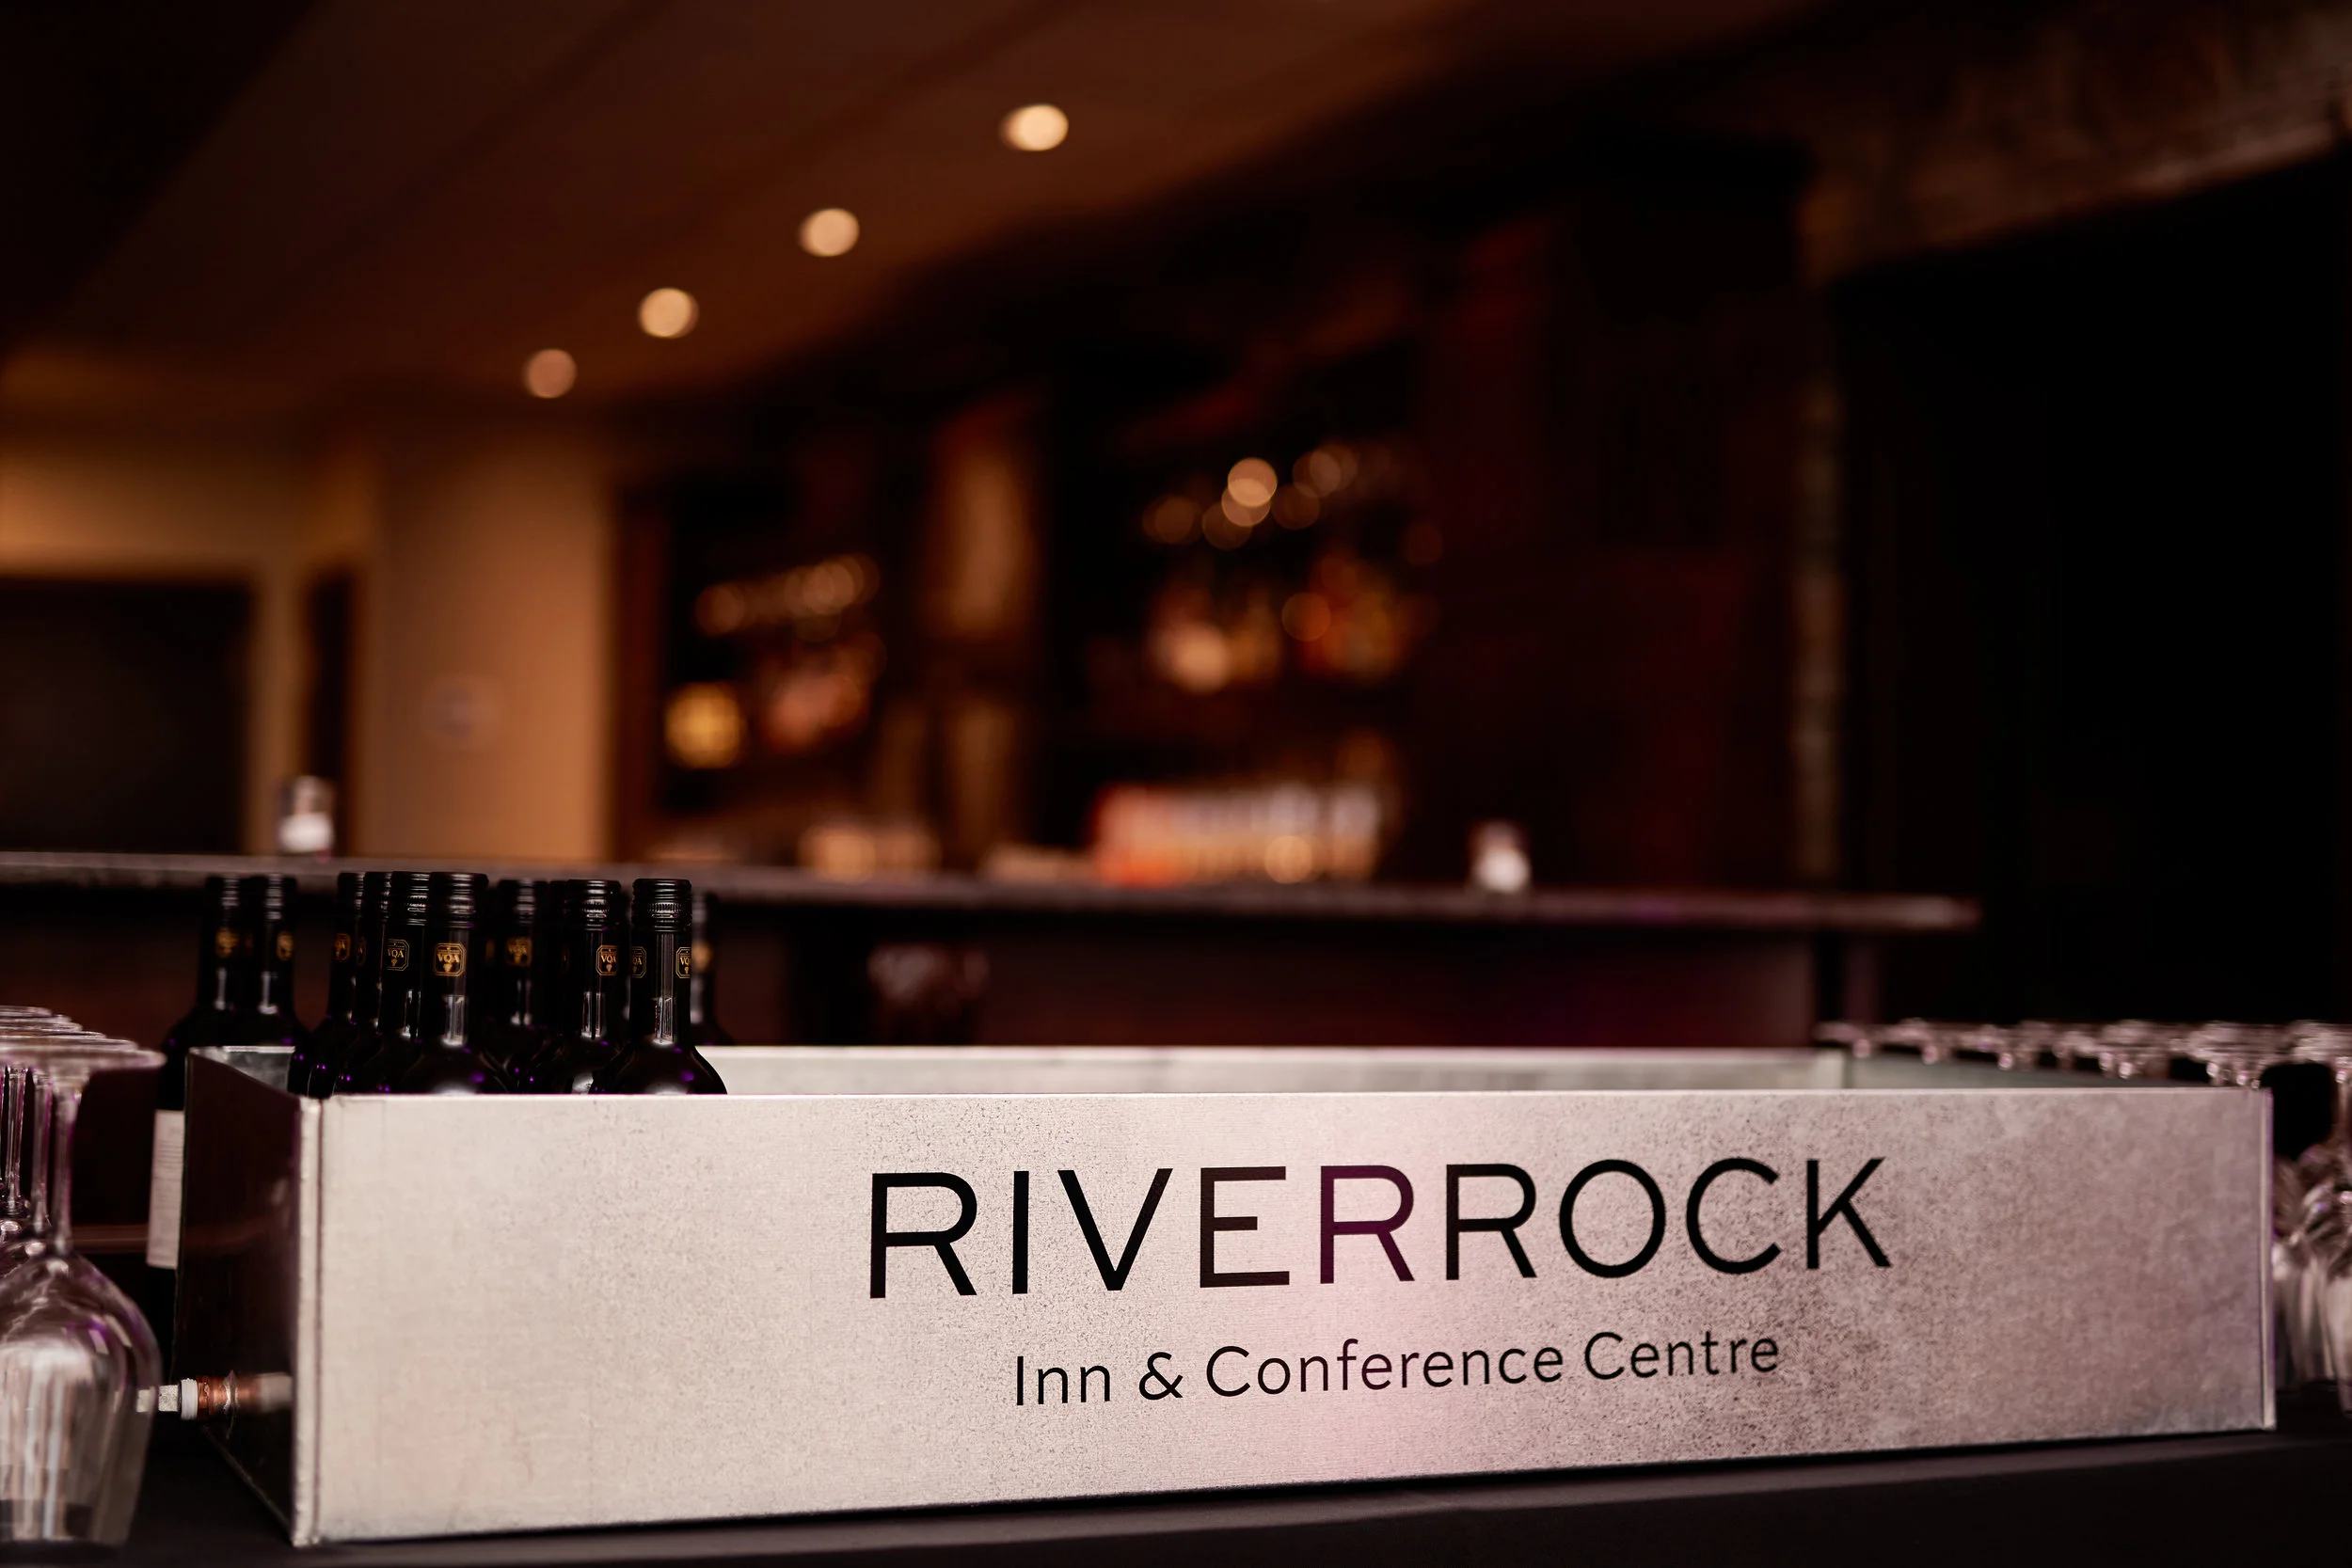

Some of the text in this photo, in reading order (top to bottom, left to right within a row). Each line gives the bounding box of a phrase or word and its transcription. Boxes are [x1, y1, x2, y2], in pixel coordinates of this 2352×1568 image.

[437, 953, 460, 963] VQA
[869, 1157, 1893, 1299] RIVERROCK
[1016, 1330, 1780, 1406] Inn & Conference Centre
